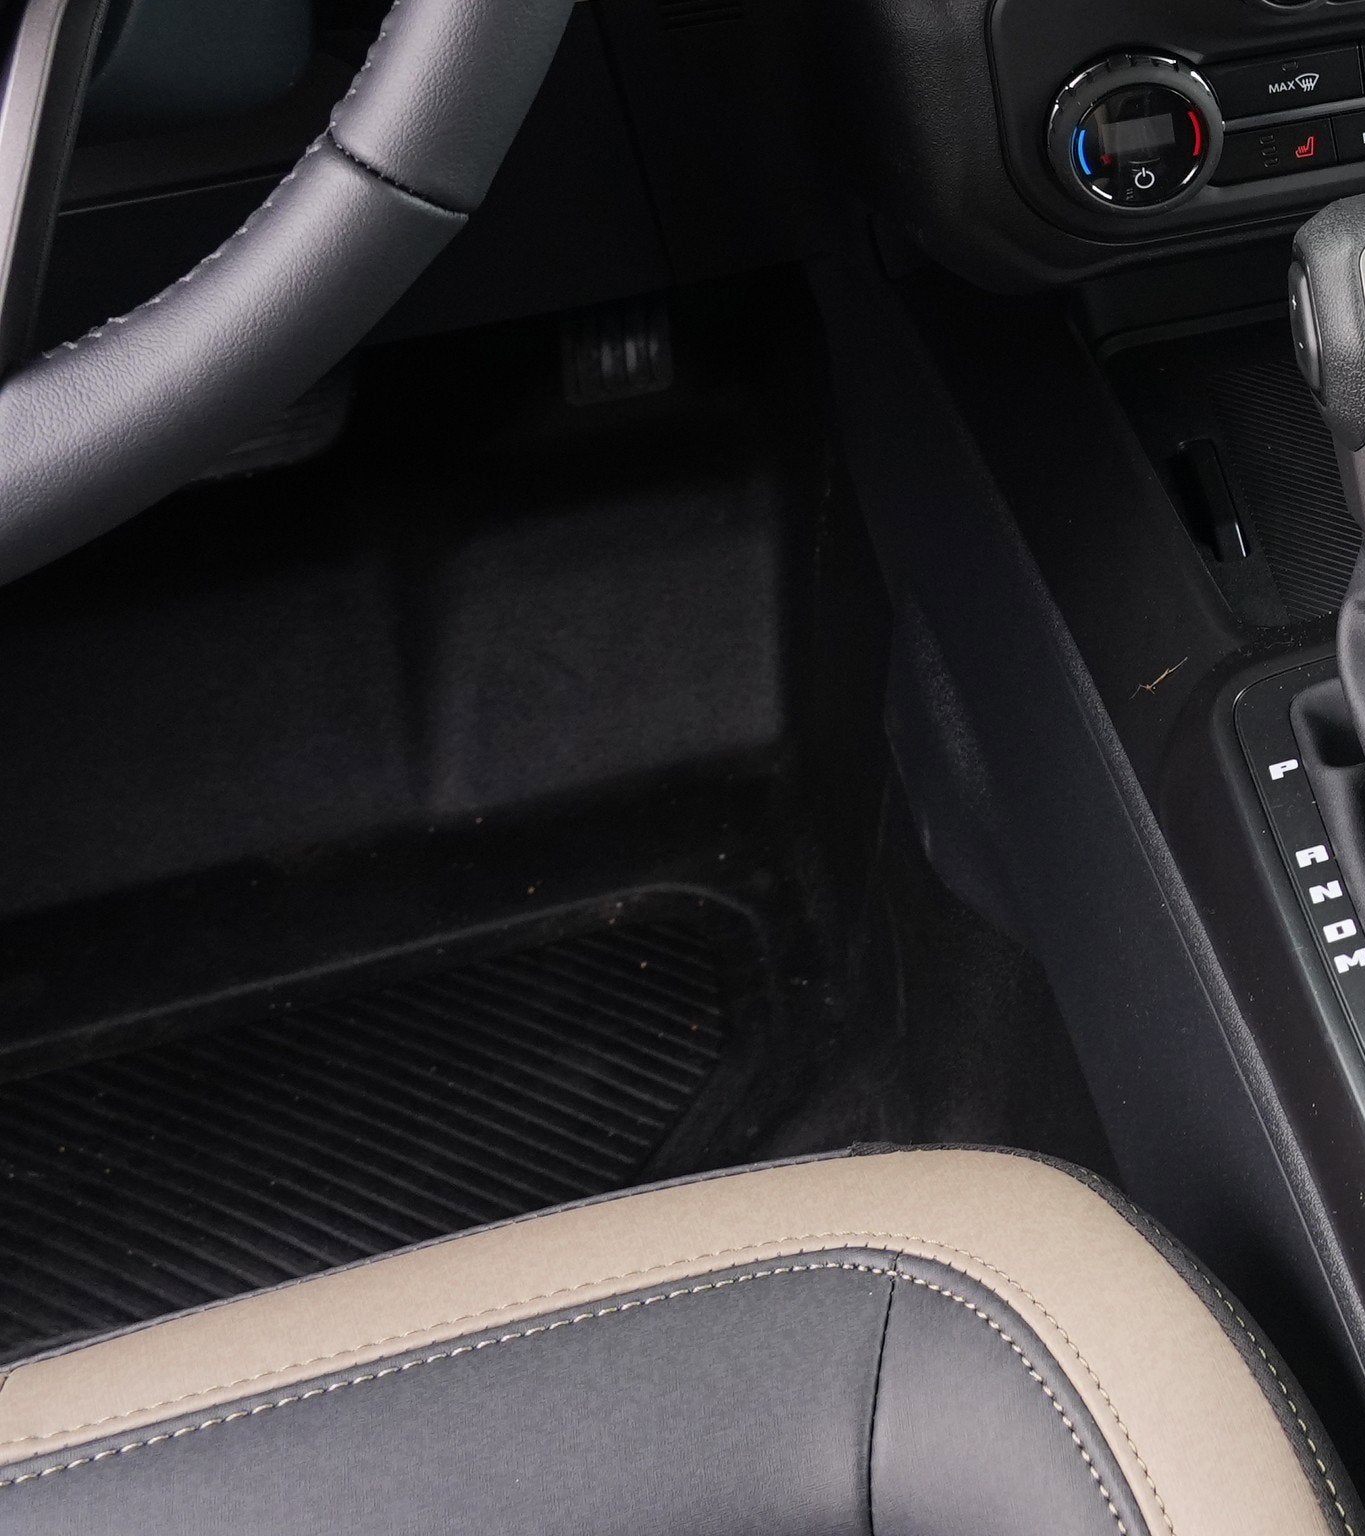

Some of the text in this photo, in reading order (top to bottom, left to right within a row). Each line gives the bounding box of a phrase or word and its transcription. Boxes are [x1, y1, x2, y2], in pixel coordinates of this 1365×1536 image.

[1268, 80, 1297, 95] MAX
[1268, 758, 1299, 781] P
[1308, 879, 1343, 905] N
[1322, 918, 1357, 944] D
